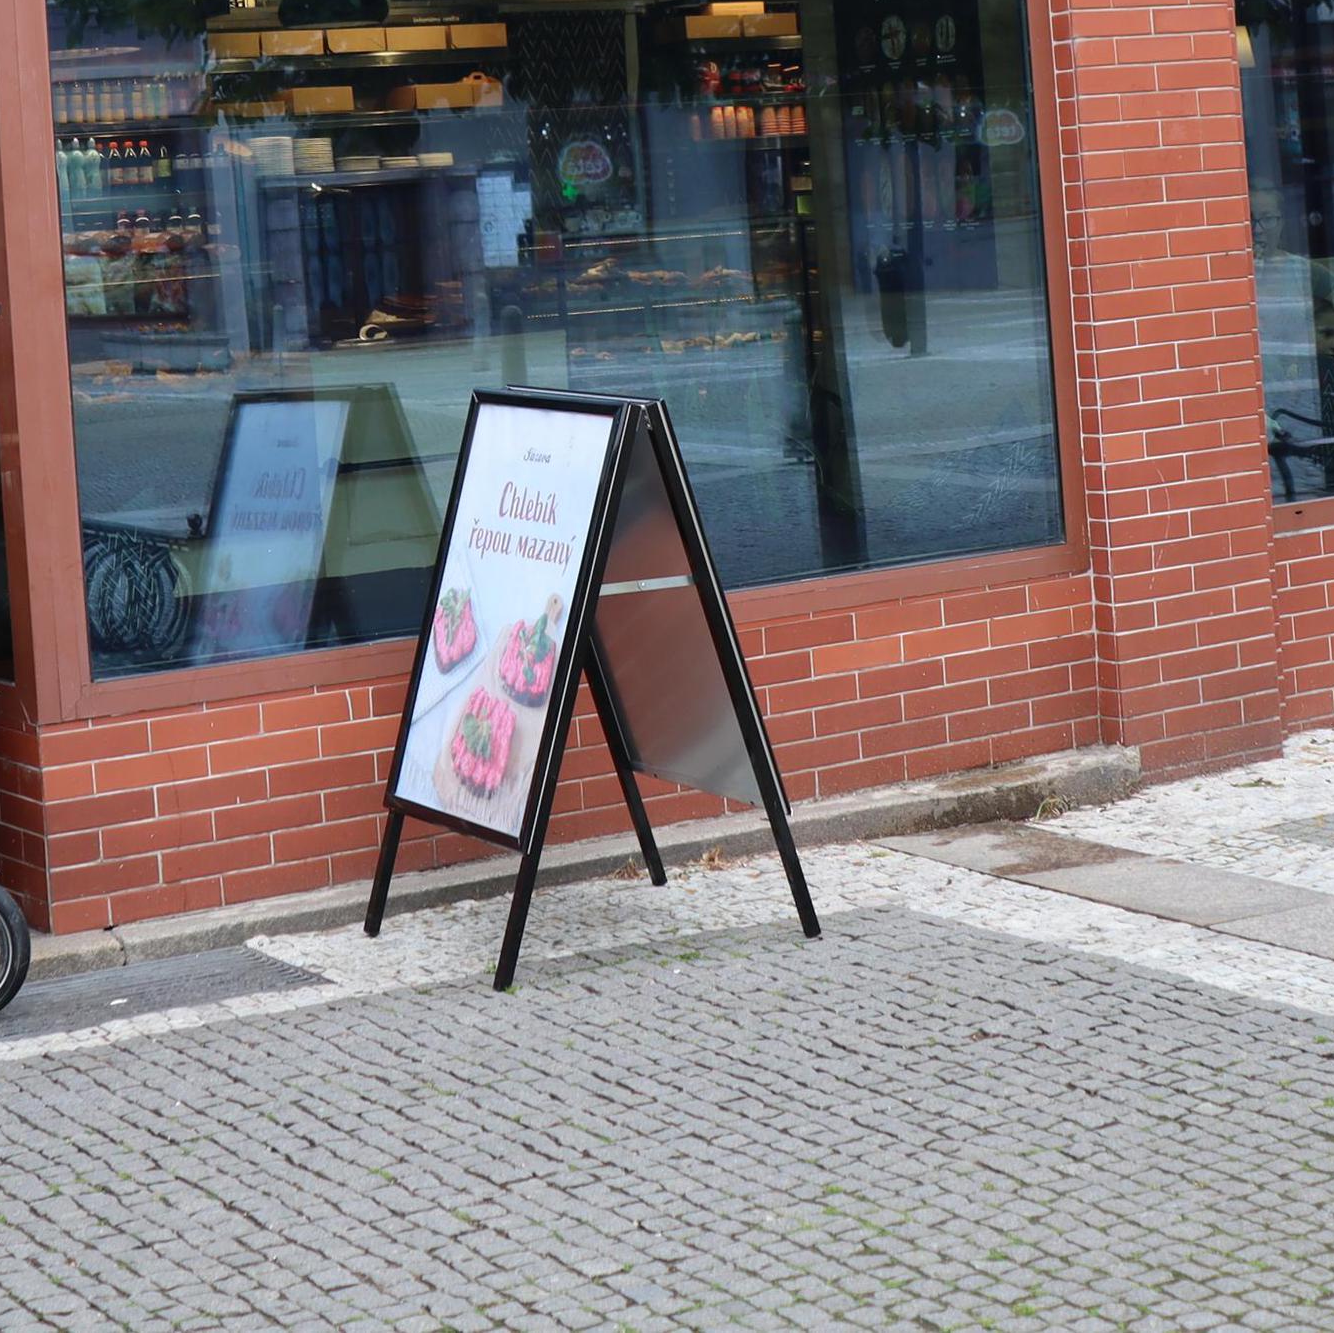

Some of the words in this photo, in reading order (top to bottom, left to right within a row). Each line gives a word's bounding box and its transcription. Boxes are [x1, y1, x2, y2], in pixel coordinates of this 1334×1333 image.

[499, 481, 558, 525] Chlebík
[468, 518, 512, 560] řepou
[515, 535, 577, 578] mazaný
